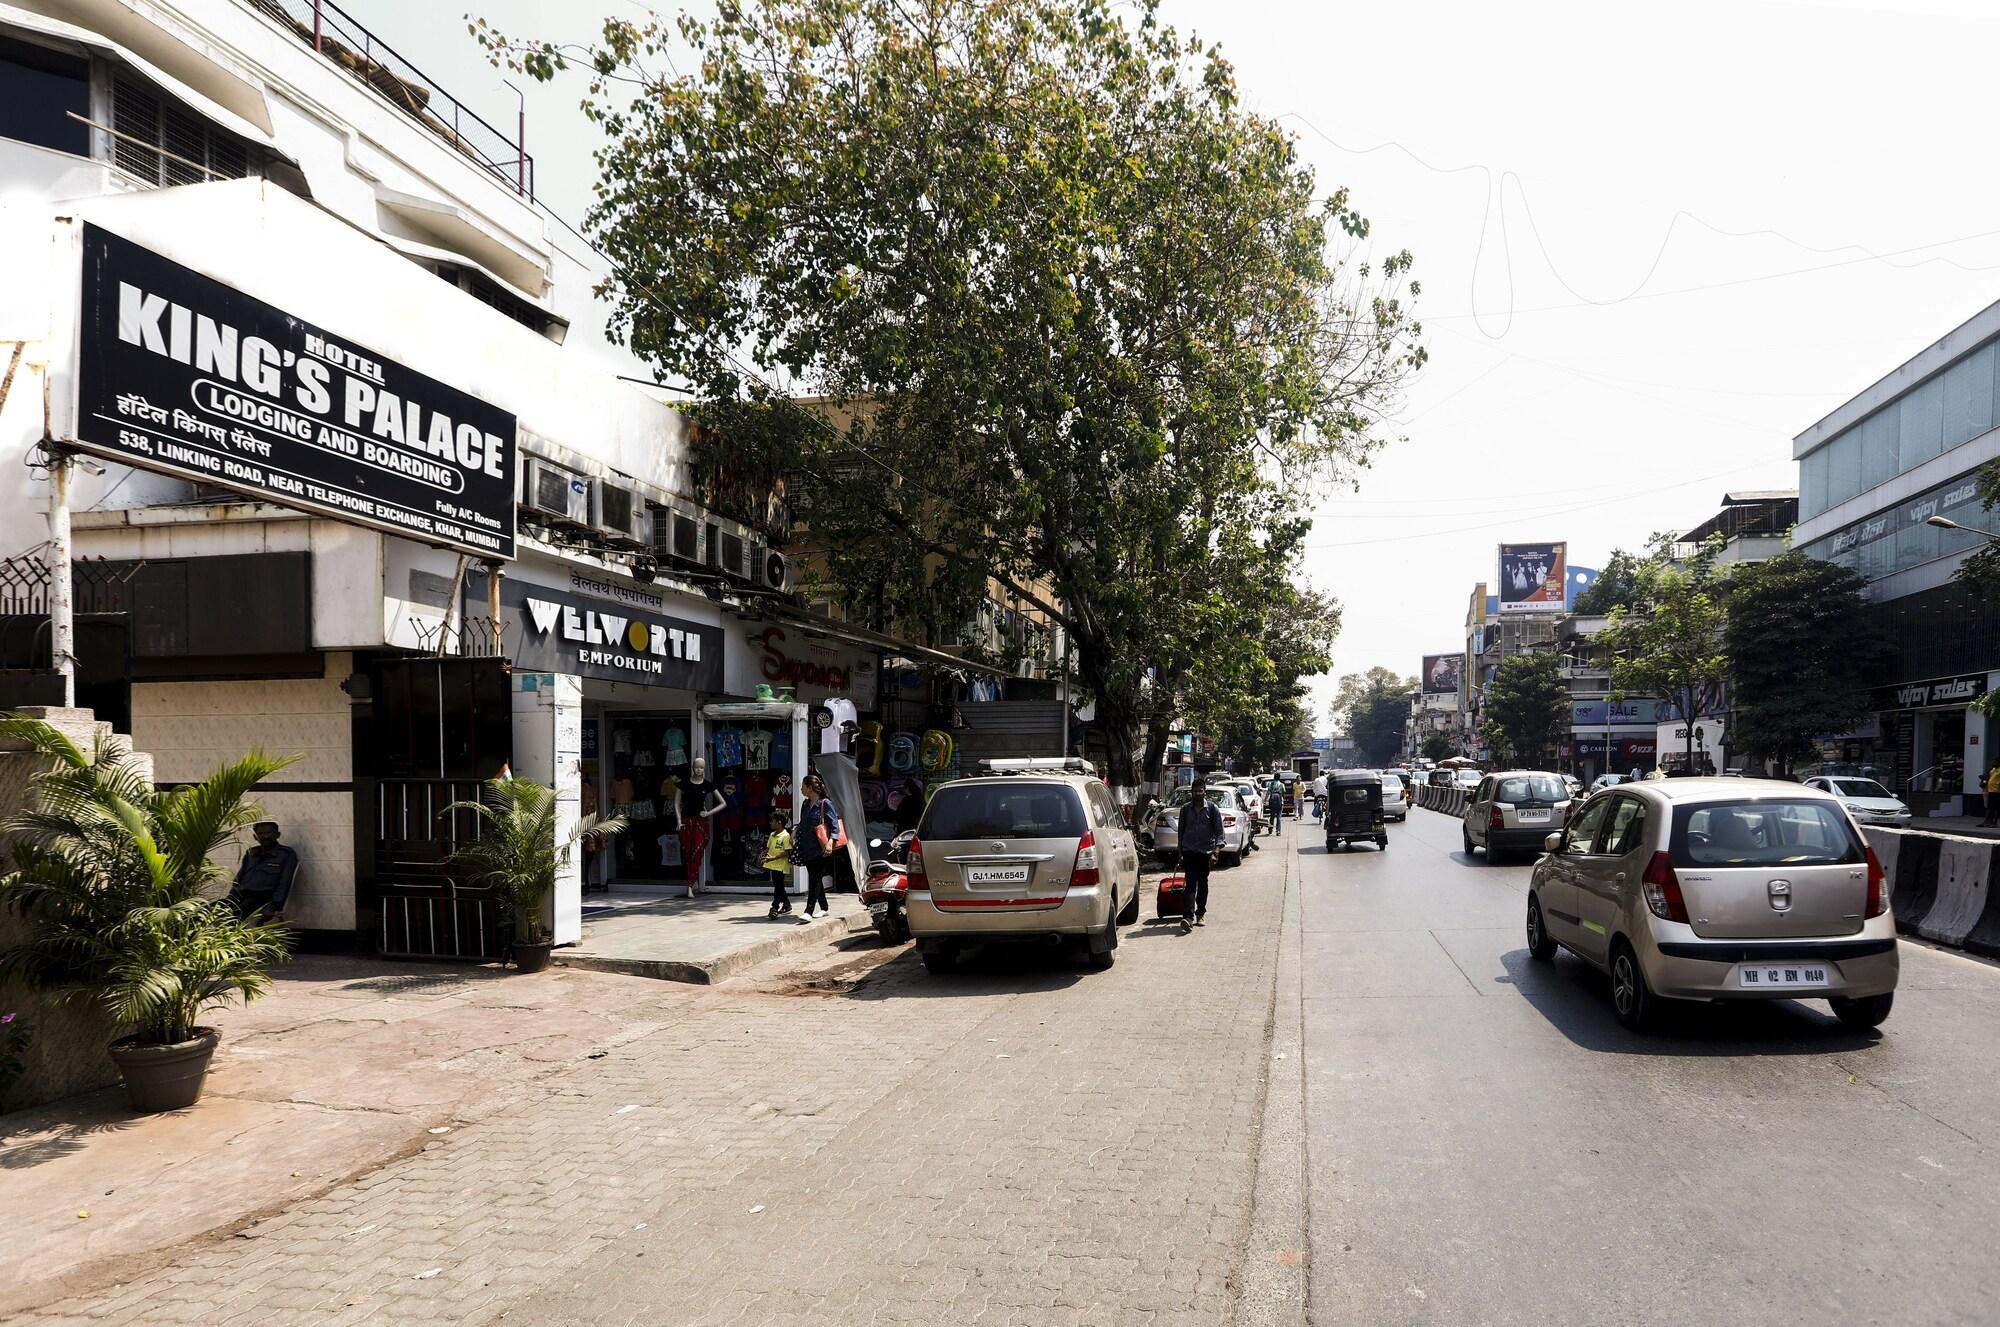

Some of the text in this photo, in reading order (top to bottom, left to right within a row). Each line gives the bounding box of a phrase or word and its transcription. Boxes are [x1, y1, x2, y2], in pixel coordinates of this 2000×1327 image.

[305, 333, 385, 382] HOTEL
[118, 280, 503, 479] KING'S PALACE
[116, 393, 272, 457] हॉटेल किंगस् पॅलेस
[210, 388, 452, 487] LODGING AND BOARDING
[119, 430, 500, 550] 538, LINKING ROAD, NEAR TELEPHONE EXCHANGE, KHAR, MUMBAI
[435, 500, 502, 529] Fully A/C Rooms
[526, 597, 701, 662] WELWORTH
[578, 648, 663, 674] EMPORIUM
[1608, 705, 1638, 716] SALE
[1897, 679, 1976, 707] vijay sales
[972, 871, 1025, 881] GJ.1.HM.6545
[1744, 970, 1758, 983] MH
[1768, 969, 1778, 982] 02
[1805, 969, 1824, 982] 0140
